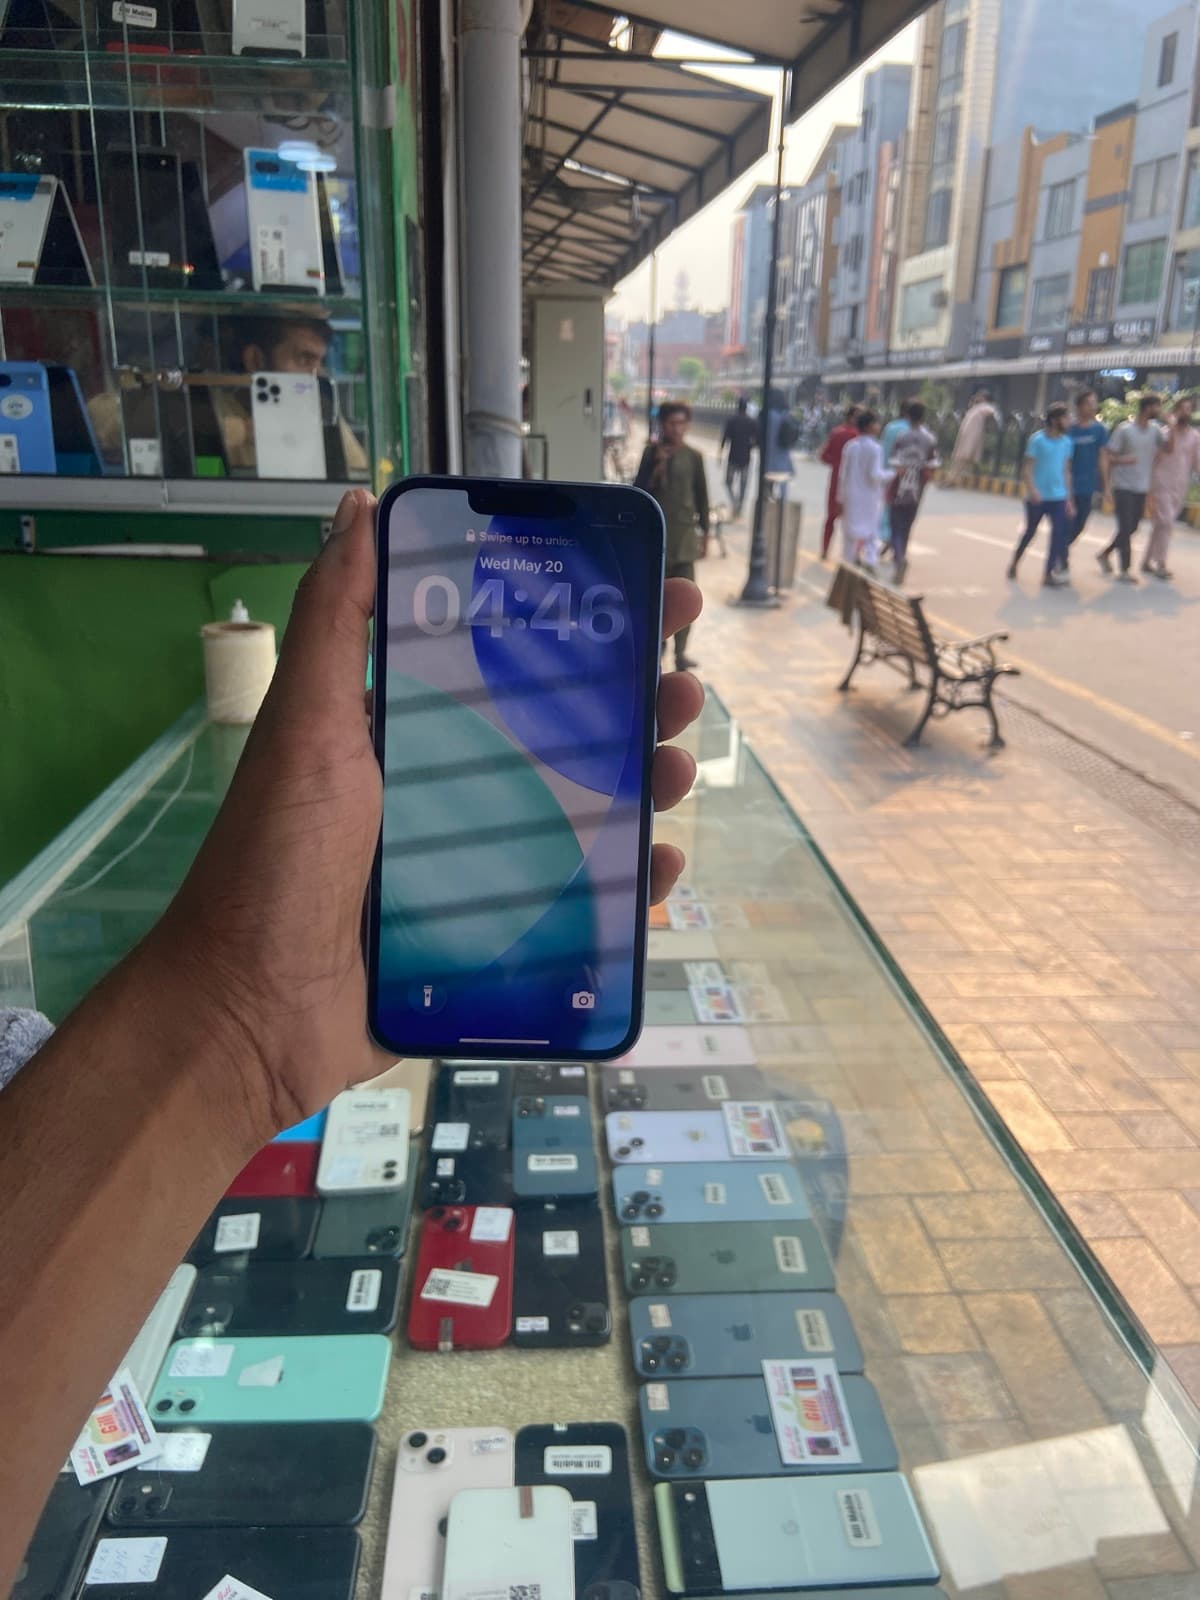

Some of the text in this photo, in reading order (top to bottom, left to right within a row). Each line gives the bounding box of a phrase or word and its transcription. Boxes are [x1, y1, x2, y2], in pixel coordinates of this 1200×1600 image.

[480, 531, 513, 545] Swipe
[515, 535, 529, 546] up
[532, 535, 543, 545] to
[480, 557, 564, 575] Wed May 20
[413, 574, 625, 644] 04:46
[97, 1413, 119, 1435] Gill
